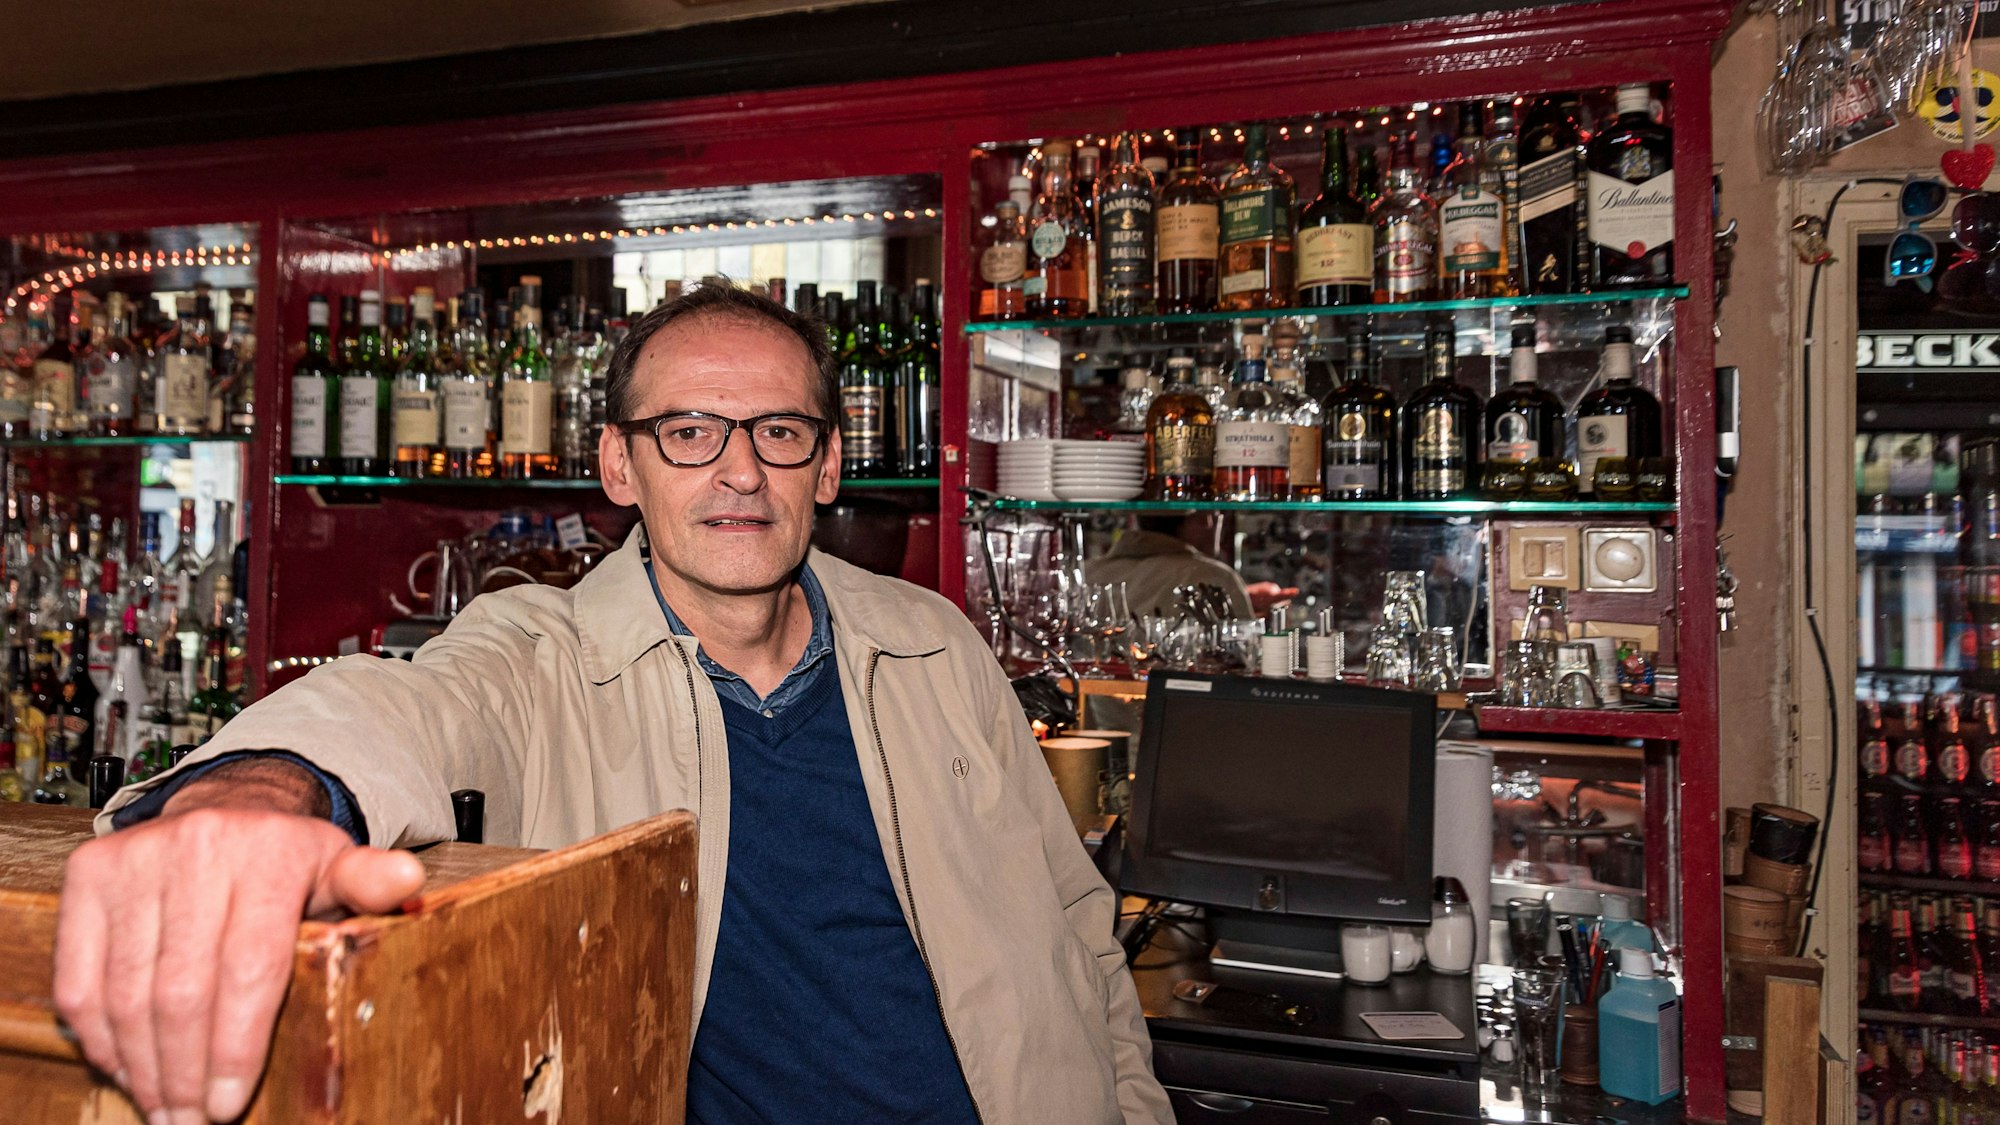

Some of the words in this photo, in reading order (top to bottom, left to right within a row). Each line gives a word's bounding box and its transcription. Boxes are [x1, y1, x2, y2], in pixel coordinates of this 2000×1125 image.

[1102, 197, 1152, 215] JAMESON
[1447, 205, 1496, 218] KILBEGGAN
[1405, 240, 1435, 254] REGAL
[1242, 447, 1256, 457] 12
